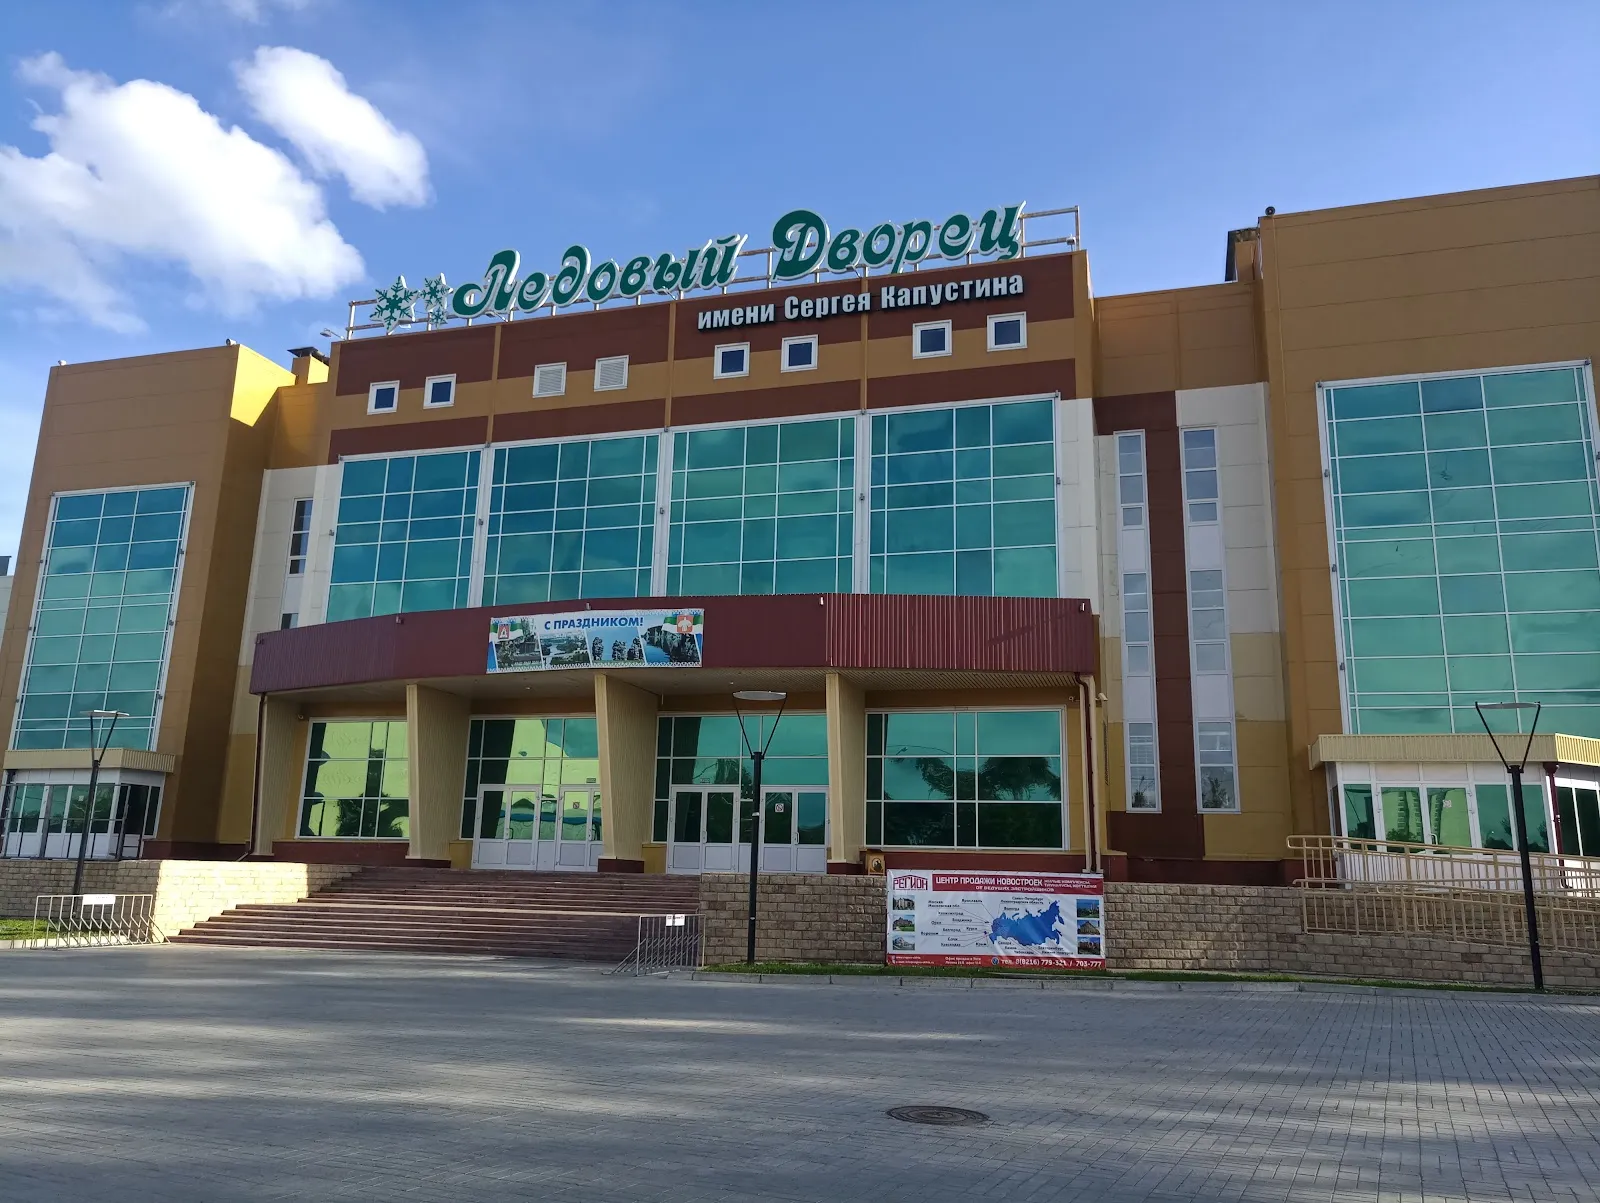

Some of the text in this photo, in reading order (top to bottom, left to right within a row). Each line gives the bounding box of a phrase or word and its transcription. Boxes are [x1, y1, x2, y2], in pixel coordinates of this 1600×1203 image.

[451, 200, 1026, 319] Ледовый Дворец
[697, 274, 1024, 330] имени Сергея Капустина
[544, 617, 644, 631] С ПРАЗДНИКОМ!
[893, 876, 928, 890] РЕГИОН
[960, 877, 995, 885] ПРОДАЖИ
[997, 878, 1043, 887] НОВОСТРОЕК
[1075, 960, 1102, 968] 703-777
